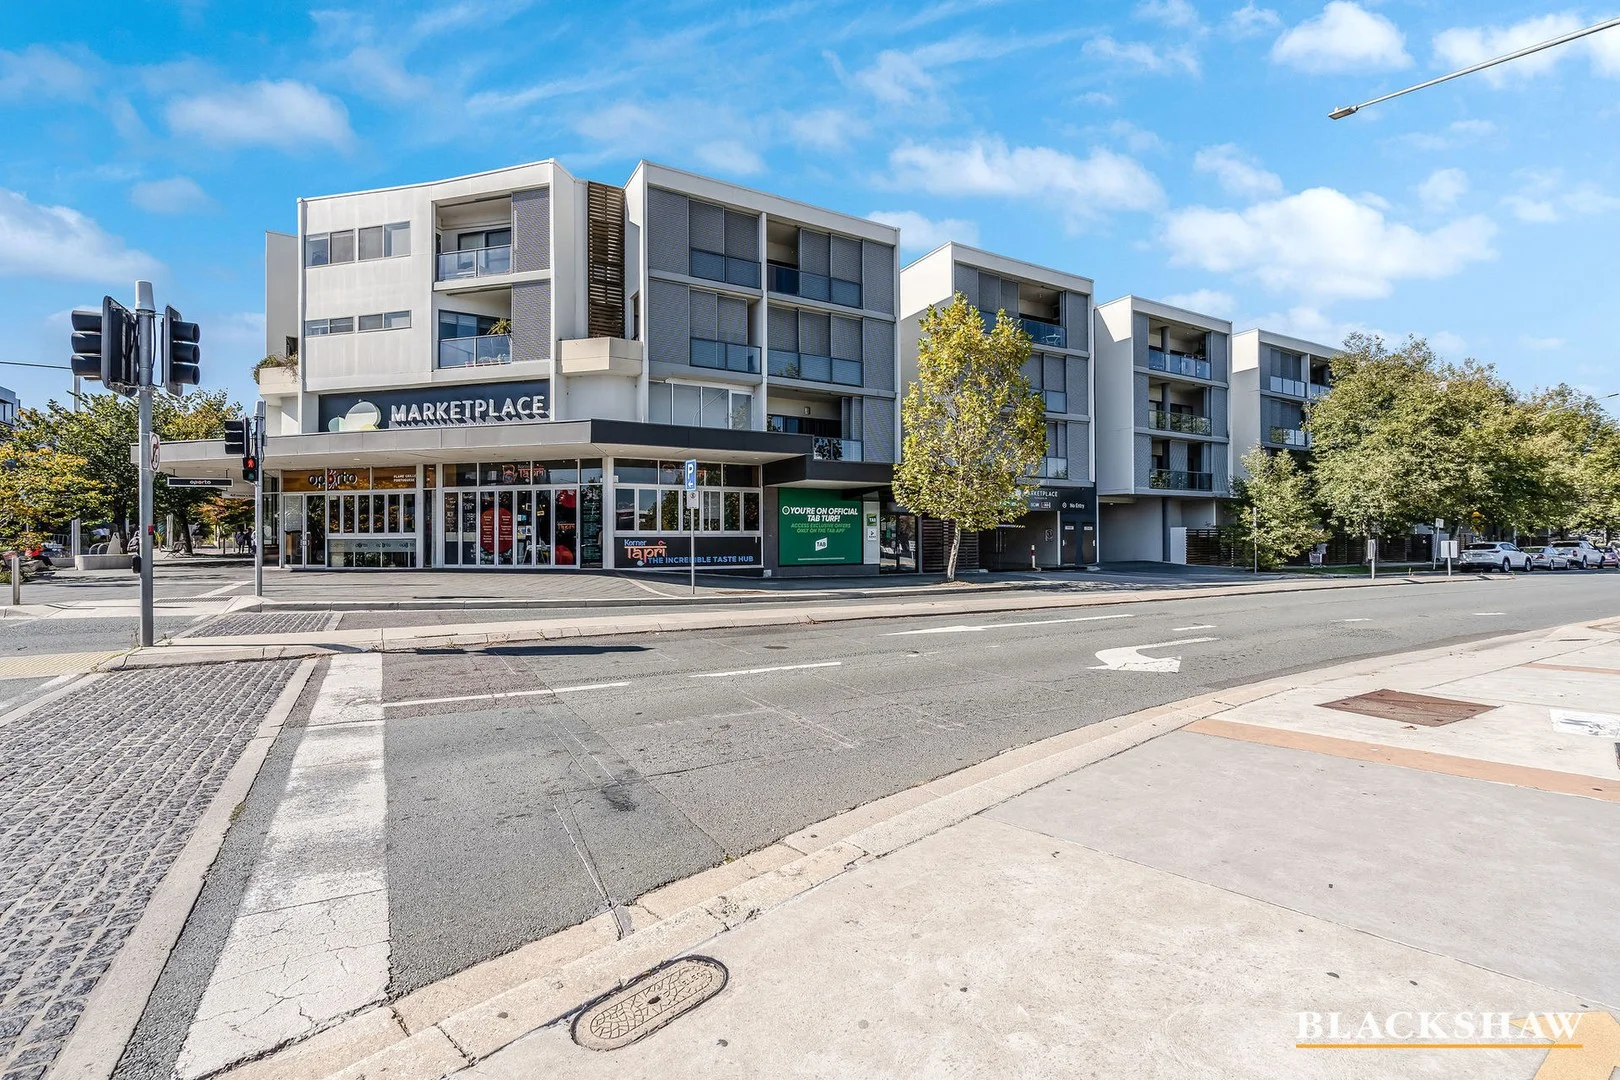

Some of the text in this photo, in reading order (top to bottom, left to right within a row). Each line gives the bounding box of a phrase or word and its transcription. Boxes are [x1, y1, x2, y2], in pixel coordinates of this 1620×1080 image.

[391, 395, 545, 422] MARKETPLACE
[308, 471, 358, 489] oporto
[687, 463, 694, 480] P
[790, 506, 858, 515] YOU'RE ON OFFICIAL
[624, 540, 667, 563] Tapri
